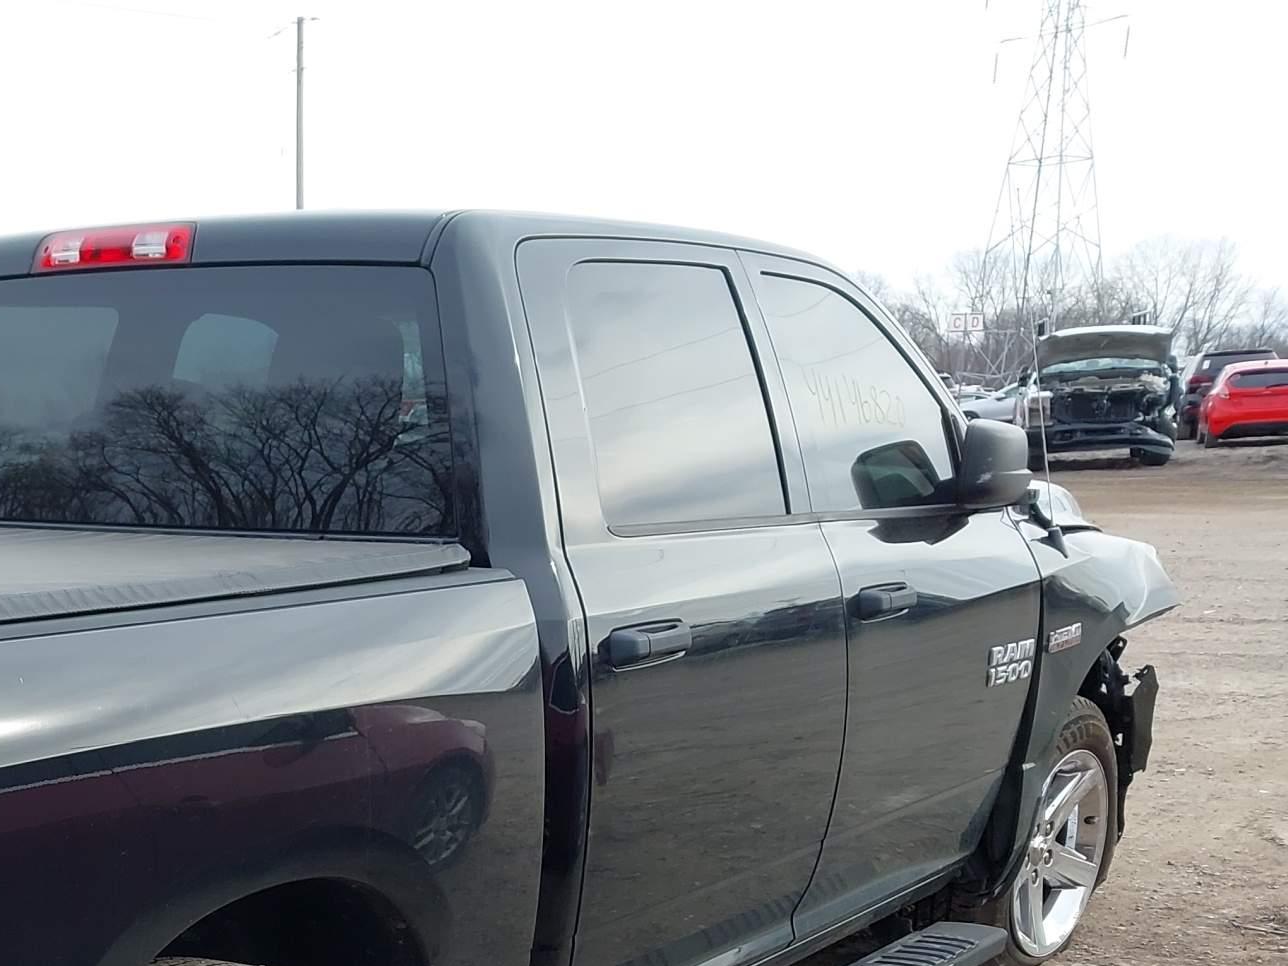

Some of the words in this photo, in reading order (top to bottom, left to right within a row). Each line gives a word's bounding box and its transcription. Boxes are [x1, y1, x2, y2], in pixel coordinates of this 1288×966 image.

[953, 316, 961, 329] C
[972, 316, 979, 328] D
[989, 638, 1035, 667] RAM
[987, 660, 1032, 688] 1500
